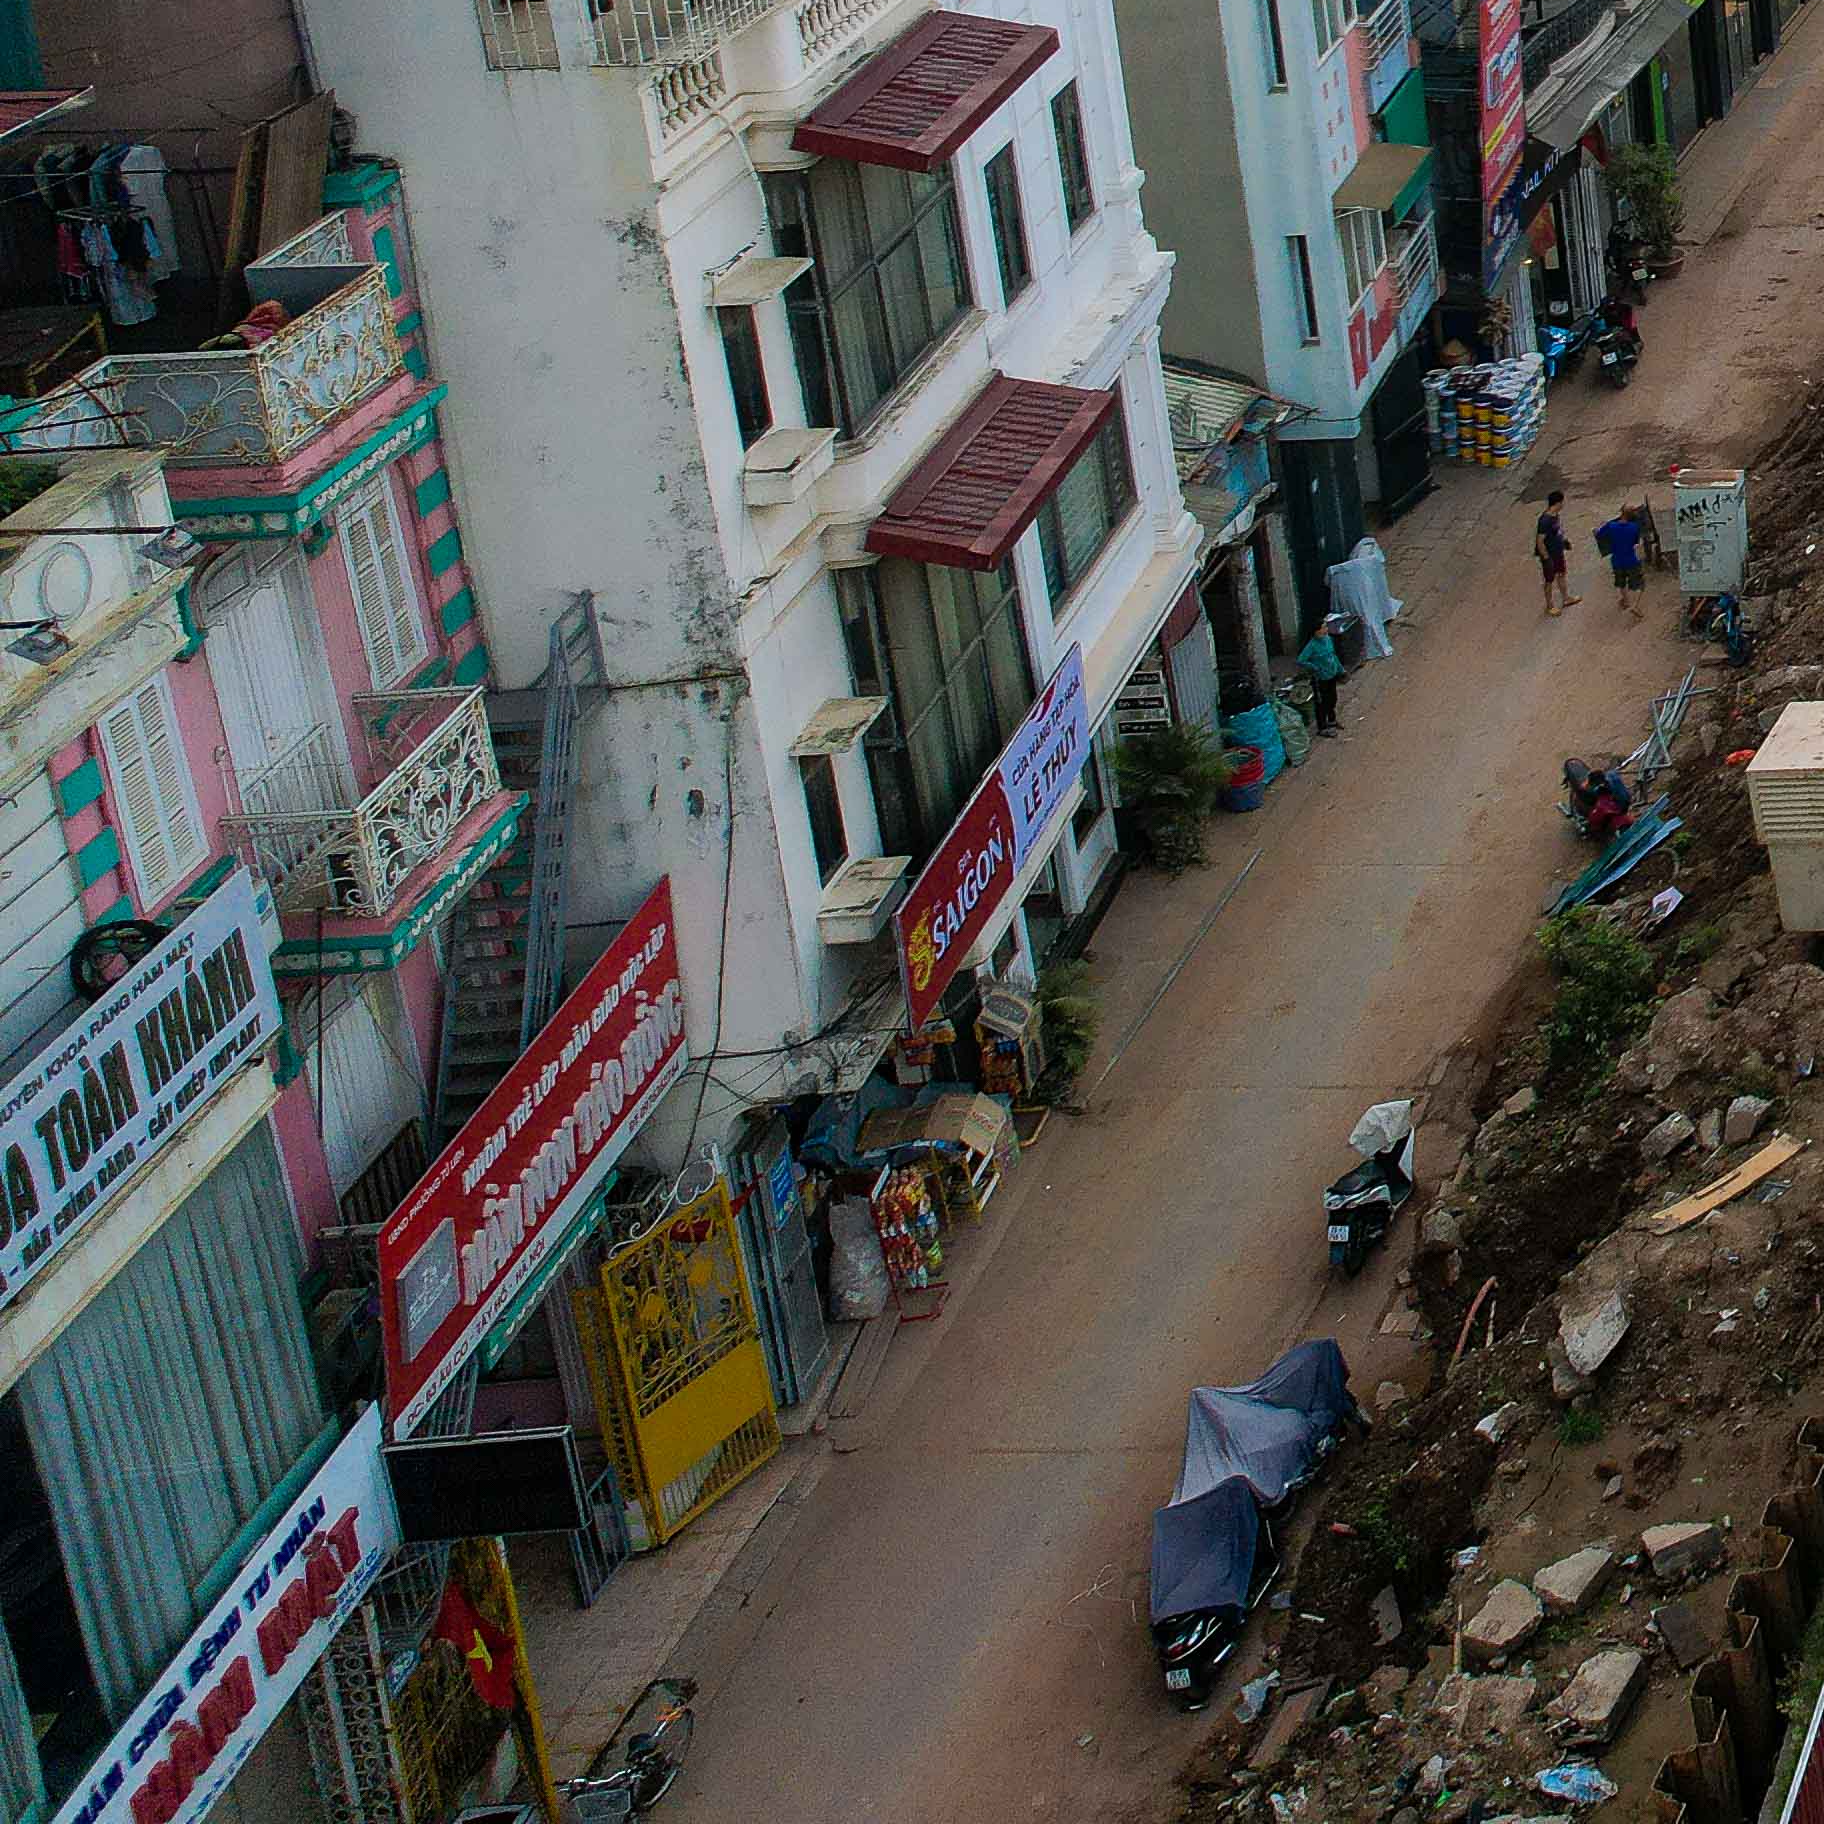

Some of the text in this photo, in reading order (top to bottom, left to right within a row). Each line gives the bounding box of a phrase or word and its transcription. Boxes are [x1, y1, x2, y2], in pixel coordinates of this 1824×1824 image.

[933, 827, 1003, 961] SAIGON
[0, 1073, 44, 1128] UYÊN
[46, 1033, 89, 1082] KHOA
[89, 992, 131, 1041] RĂNG
[131, 959, 164, 1000] HÀM
[34, 1038, 140, 1194] TOÀN
[135, 926, 257, 1098] KHÁNH
[462, 1125, 507, 1196] NHÓM
[505, 1084, 535, 1139] TRẺ
[532, 1059, 560, 1108] LỚP
[590, 983, 620, 1034] GIÁO
[644, 921, 667, 966] LẬP
[461, 1182, 526, 1307] MẦM
[519, 1114, 578, 1227] NON
[619, 977, 684, 1096] HỒNG
[185, 1604, 243, 1689] BỆNH
[242, 1561, 272, 1612] TƯ
[271, 1494, 327, 1578] NHÂN
[256, 1505, 362, 1677] MẶT
